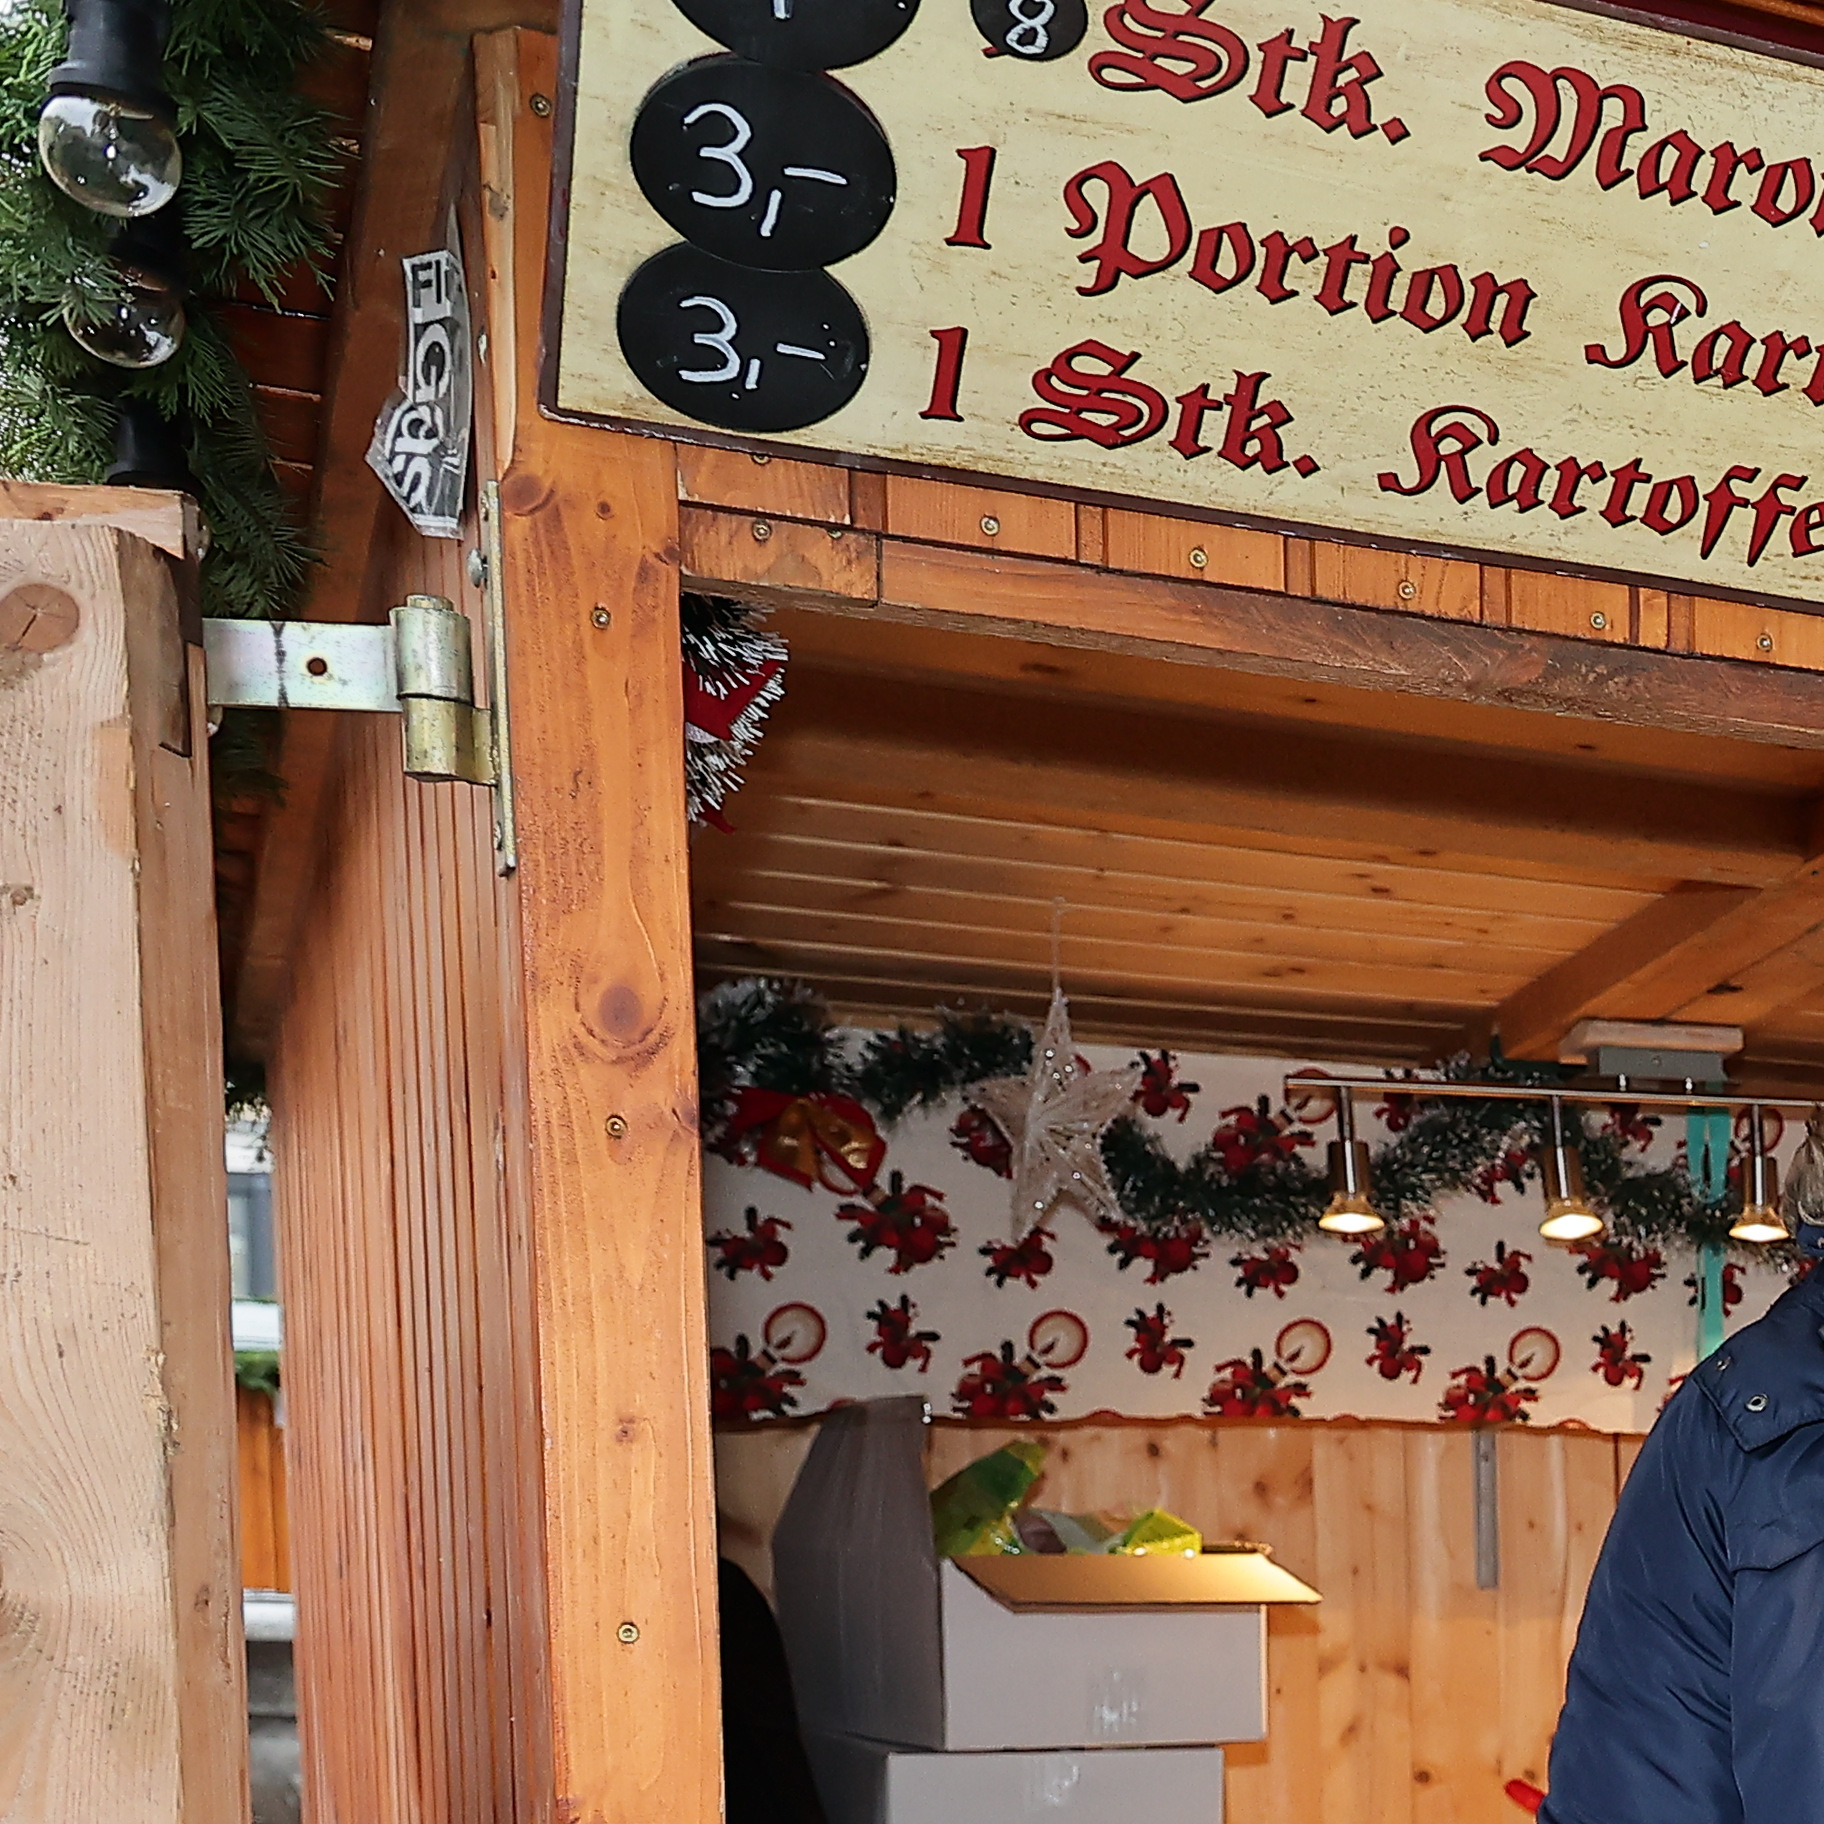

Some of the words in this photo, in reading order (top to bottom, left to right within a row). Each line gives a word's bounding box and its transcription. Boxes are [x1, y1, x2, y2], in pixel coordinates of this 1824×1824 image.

[1087, 0, 1412, 146] Stk.
[944, 145, 998, 250] 1
[1062, 159, 1537, 346] Portion
[918, 325, 969, 423] 1
[1017, 338, 1320, 479] Stk.
